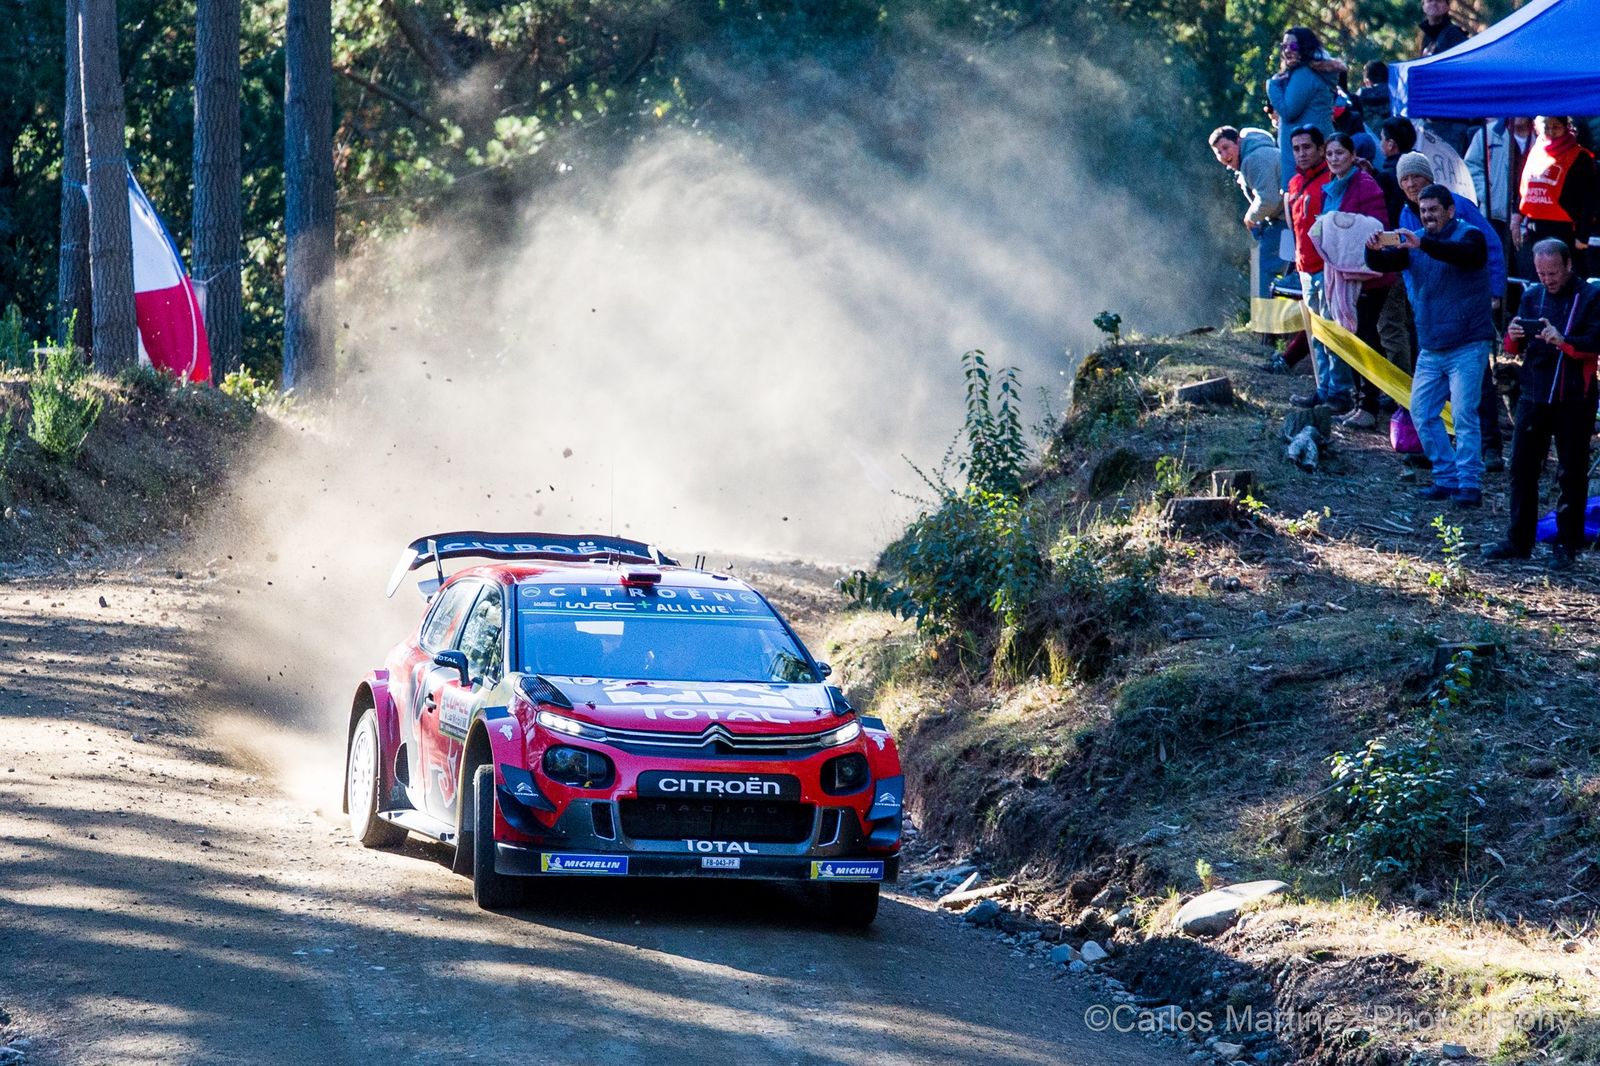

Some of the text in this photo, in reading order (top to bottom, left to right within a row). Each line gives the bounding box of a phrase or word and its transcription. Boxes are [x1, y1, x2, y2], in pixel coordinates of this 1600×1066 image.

[656, 603, 690, 613] ALL
[691, 604, 729, 614] LIVE
[631, 706, 792, 724] TOTAL
[681, 839, 759, 854] TOTAL
[564, 860, 621, 869] MICHELIN
[835, 867, 880, 875] MICHELIN
